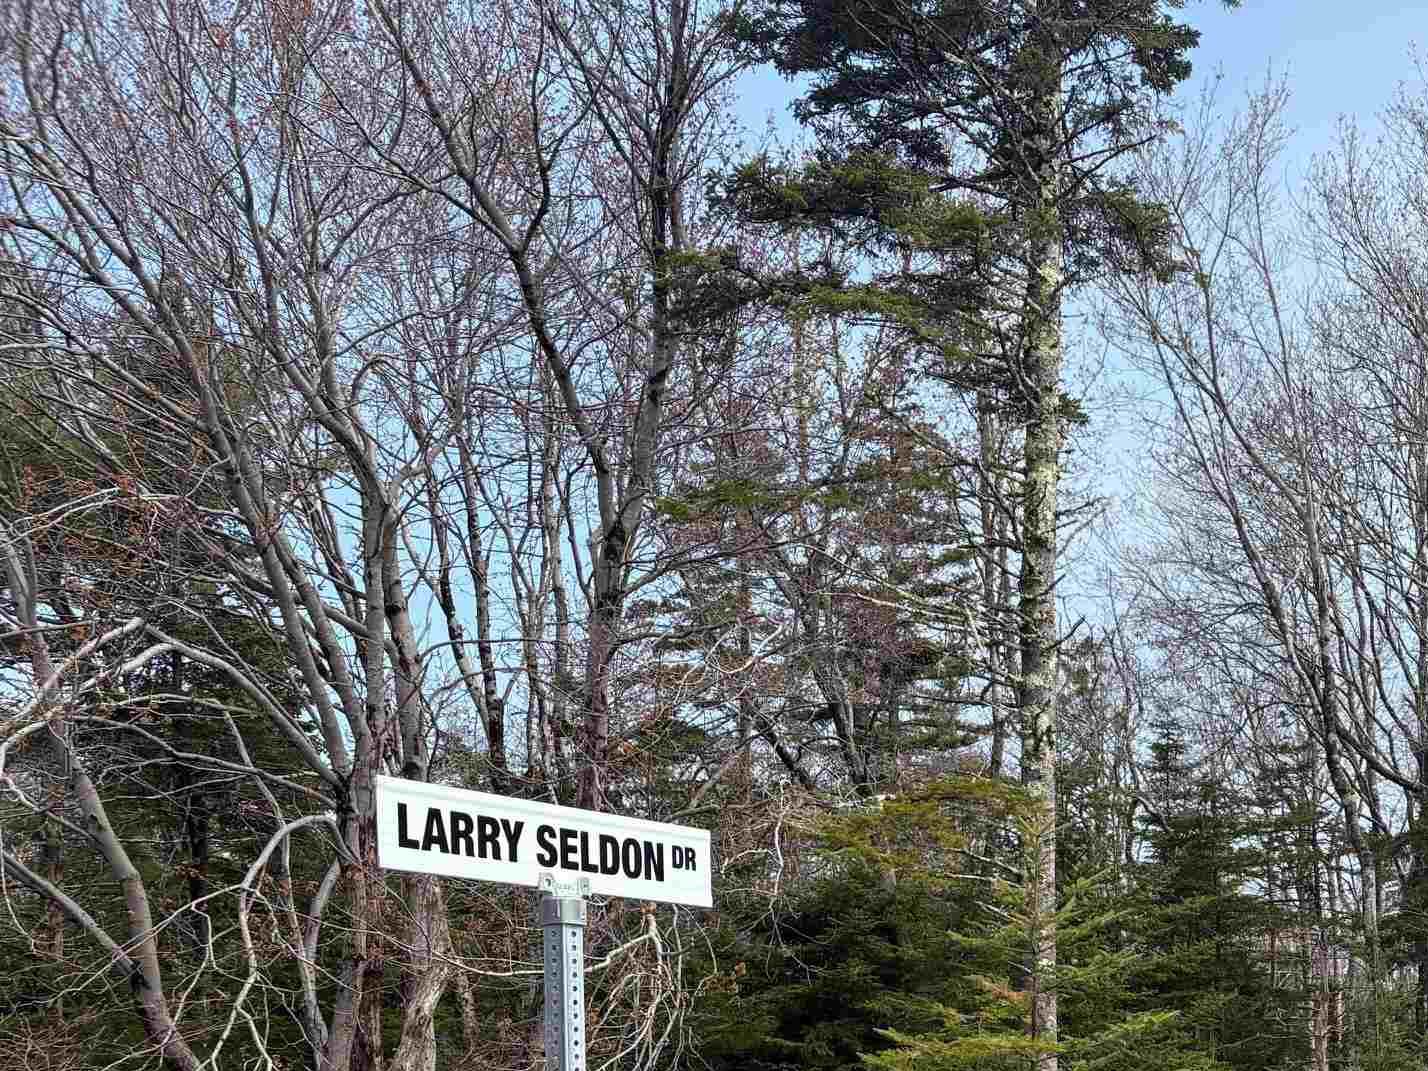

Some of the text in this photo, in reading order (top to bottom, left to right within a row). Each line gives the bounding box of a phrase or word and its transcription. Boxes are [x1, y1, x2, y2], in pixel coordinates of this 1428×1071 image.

[397, 803, 697, 882] LARRY SELDON DR
